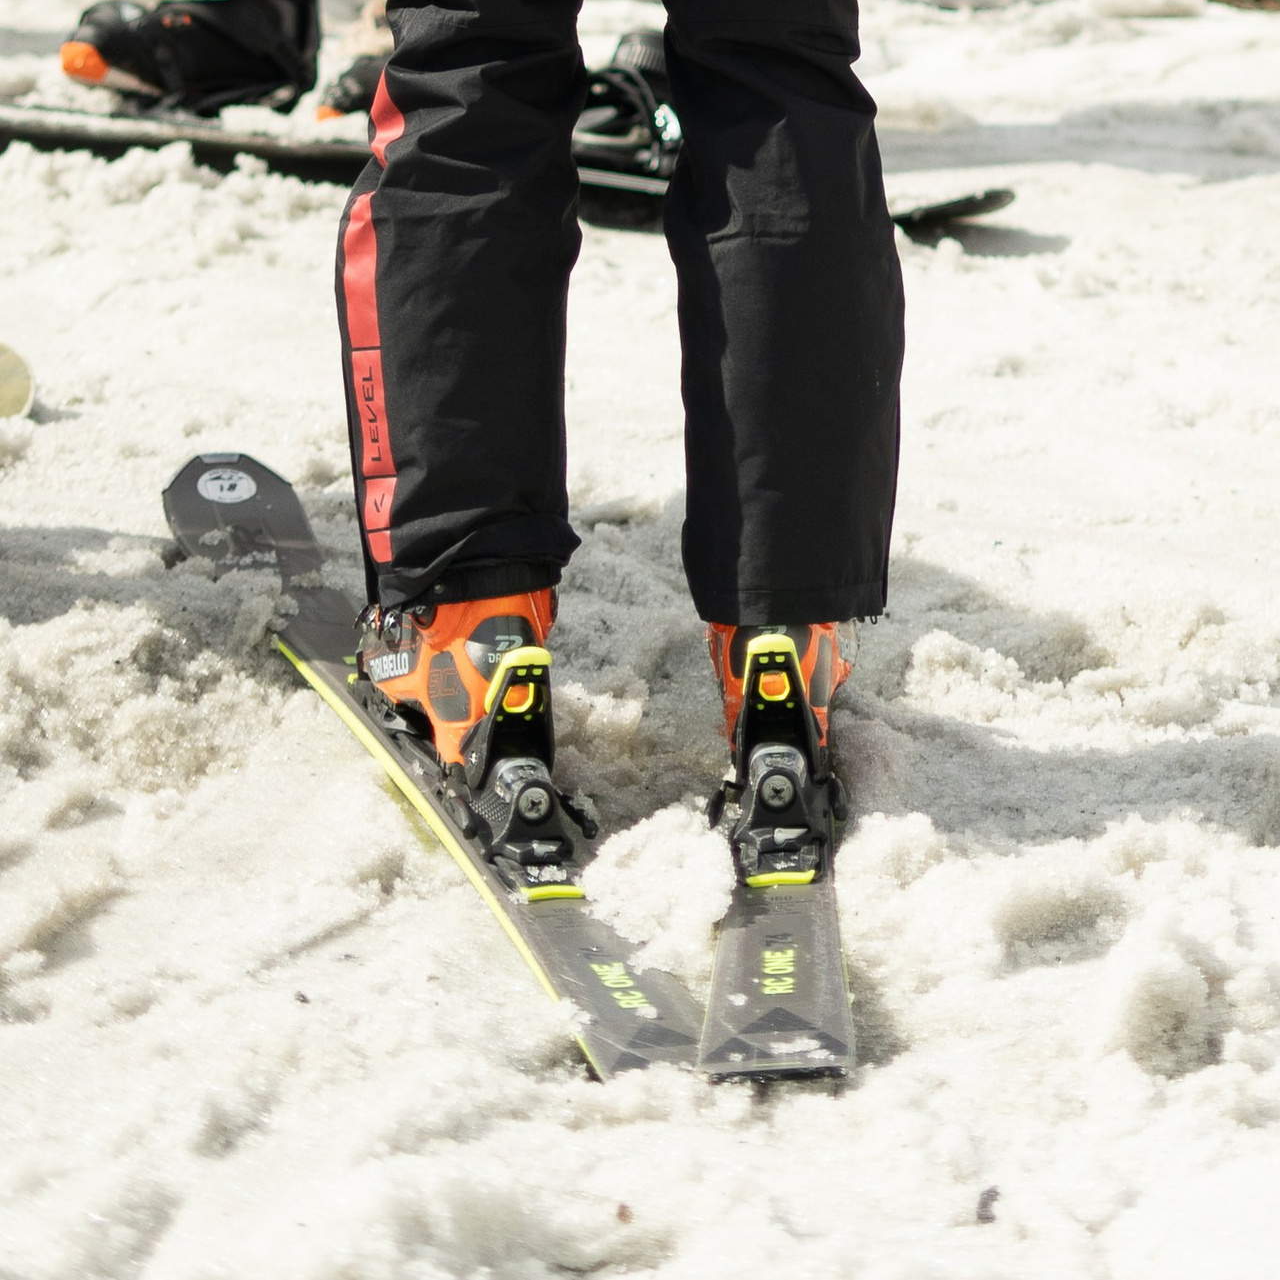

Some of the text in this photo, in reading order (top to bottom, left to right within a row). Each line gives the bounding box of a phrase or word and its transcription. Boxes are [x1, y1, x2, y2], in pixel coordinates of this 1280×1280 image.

[362, 366, 382, 462] LEVEL
[589, 961, 635, 988] ONE
[763, 949, 795, 975] ONE
[763, 977, 795, 995] RC
[612, 990, 651, 1009] RC
